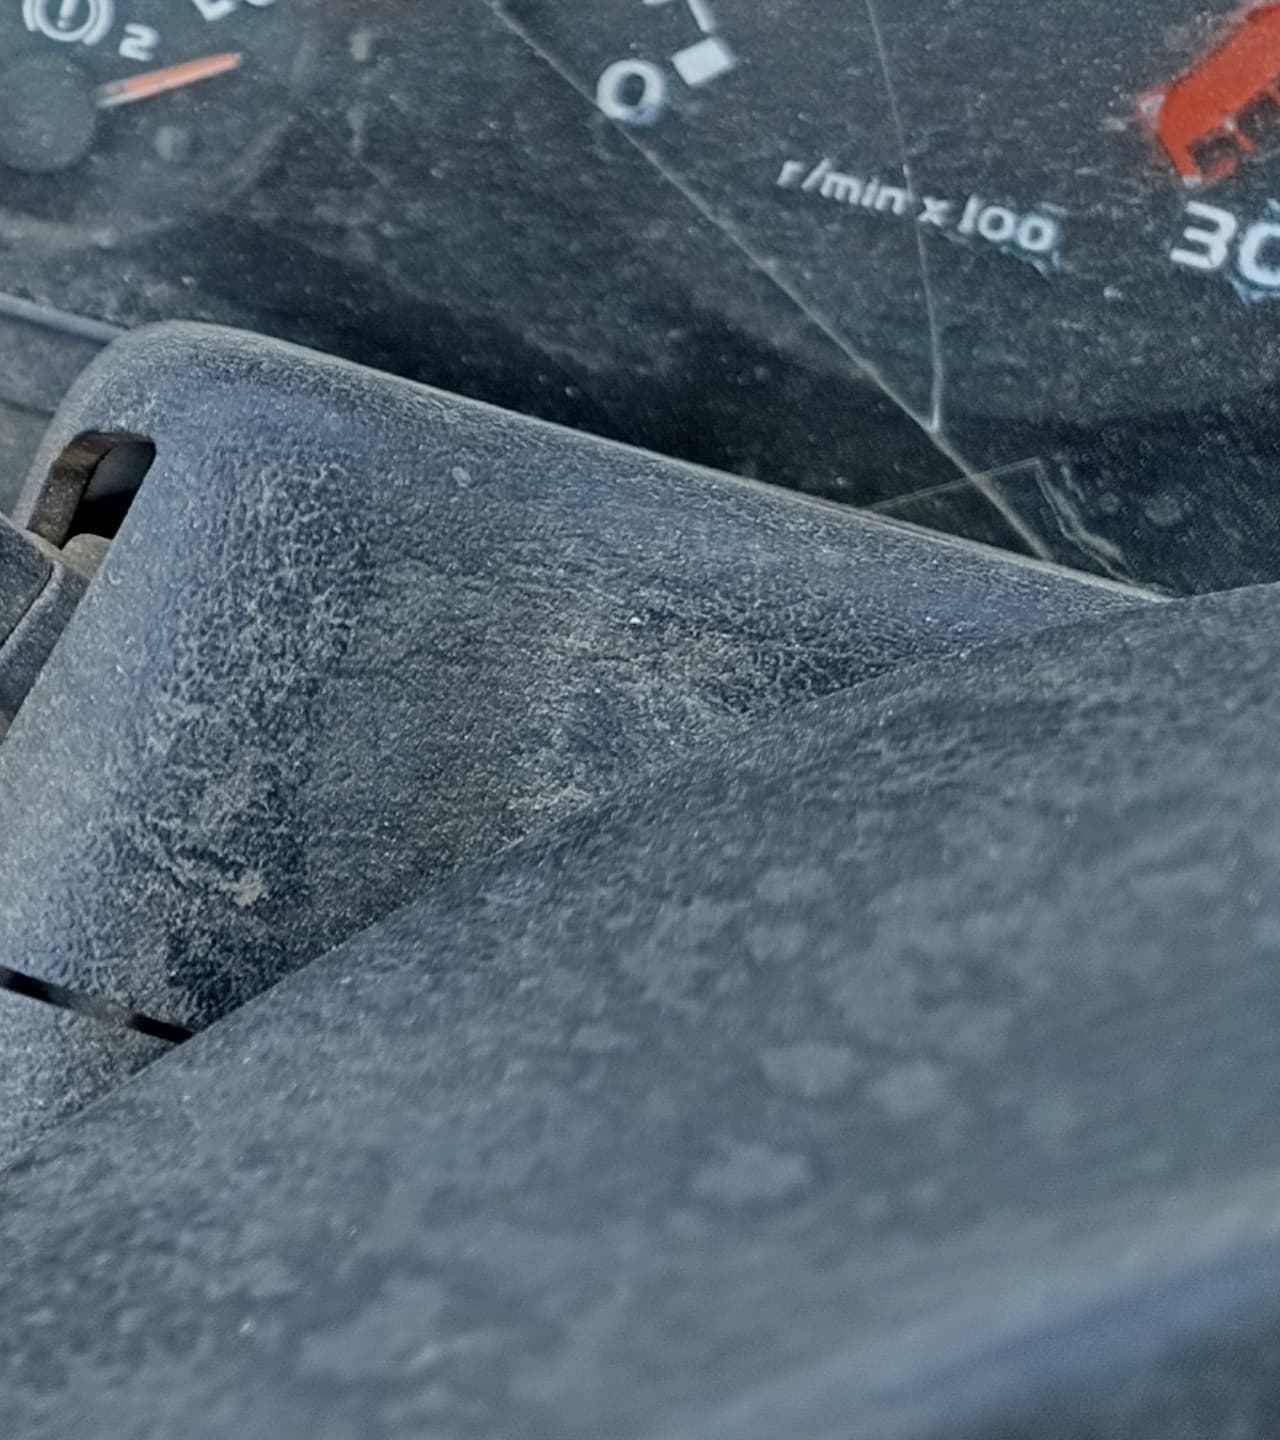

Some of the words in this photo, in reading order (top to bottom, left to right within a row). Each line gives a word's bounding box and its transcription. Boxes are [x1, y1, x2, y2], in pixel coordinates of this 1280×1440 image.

[118, 23, 160, 61] 2
[596, 58, 666, 126] 0
[776, 157, 908, 216] r/min
[957, 193, 1057, 250] 100
